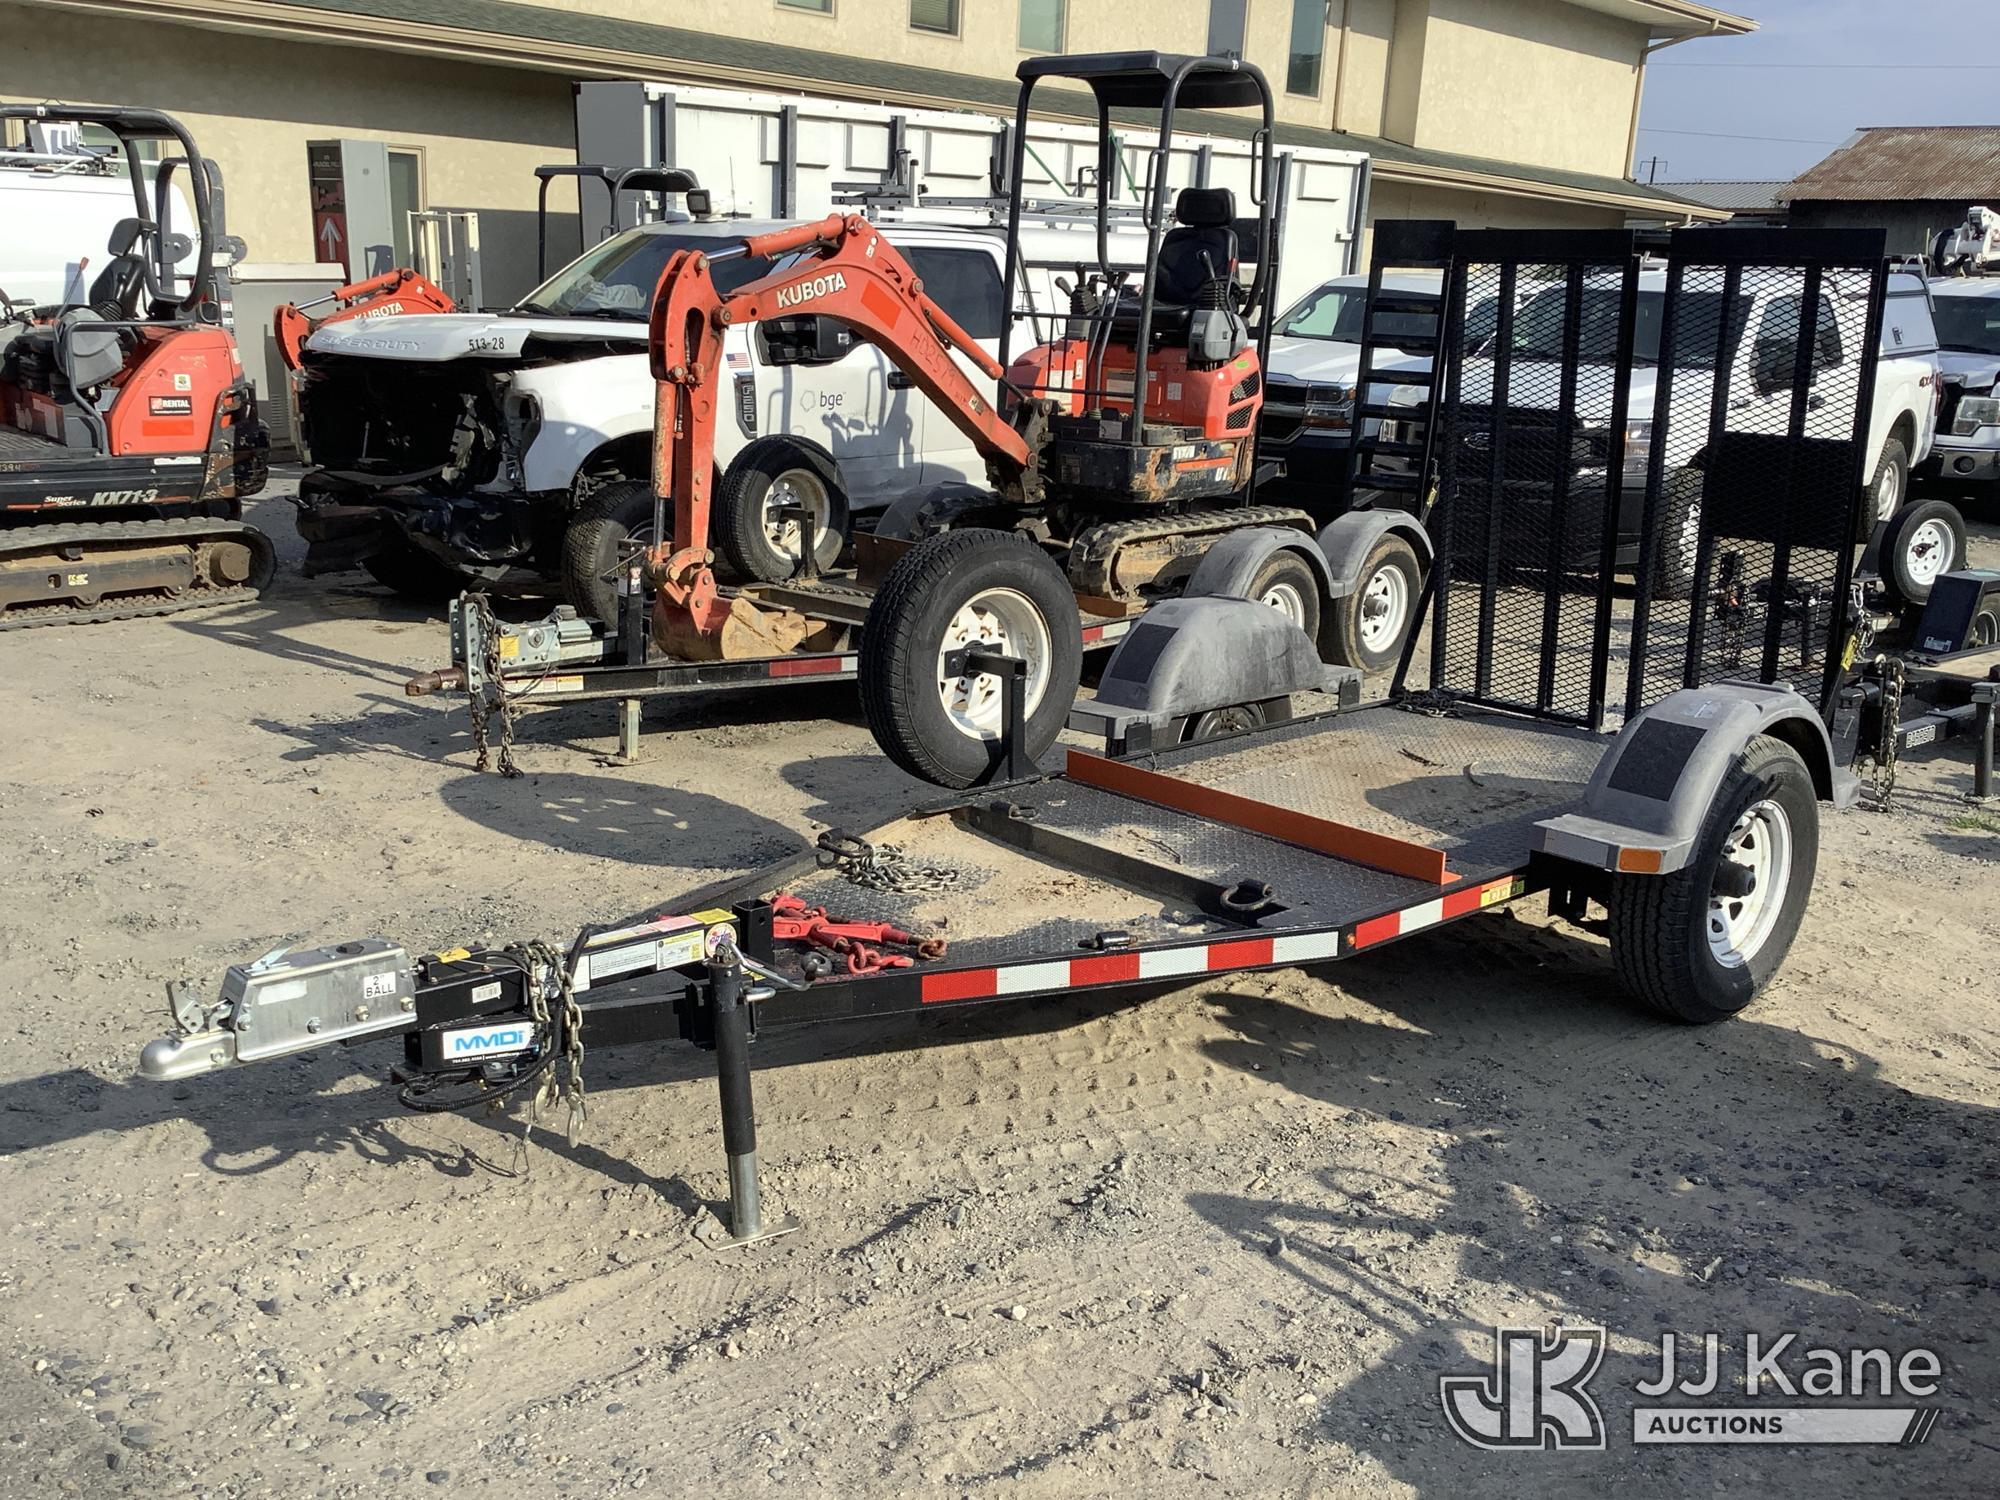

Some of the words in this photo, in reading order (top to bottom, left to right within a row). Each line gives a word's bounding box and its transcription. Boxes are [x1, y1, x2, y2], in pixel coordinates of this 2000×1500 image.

[776, 271, 847, 309] KUBOTA
[320, 335, 372, 348] SUPER
[373, 340, 421, 351] DUTY
[468, 336, 506, 352] 513-28
[162, 399, 191, 408] RENTAL
[819, 390, 843, 411] bge
[44, 495, 74, 504] Super
[58, 498, 87, 507] Series
[90, 488, 159, 507] KX71-3
[365, 981, 395, 998] BALL
